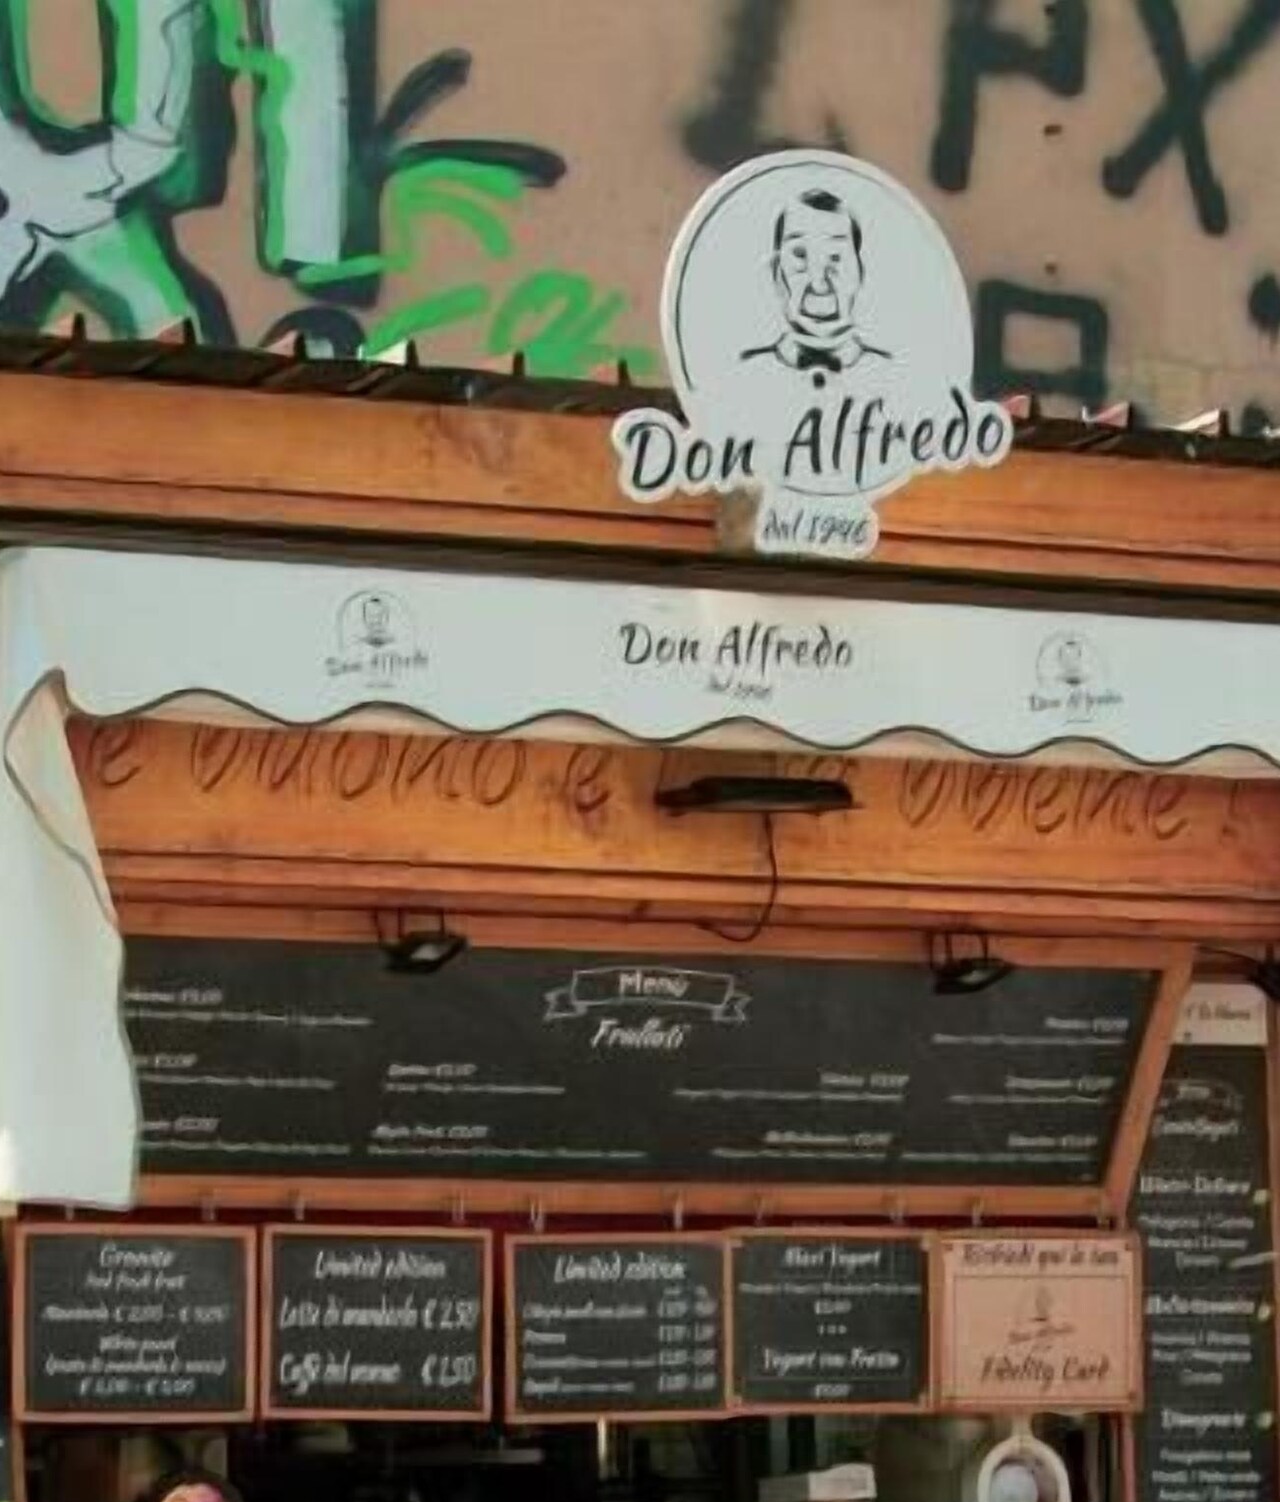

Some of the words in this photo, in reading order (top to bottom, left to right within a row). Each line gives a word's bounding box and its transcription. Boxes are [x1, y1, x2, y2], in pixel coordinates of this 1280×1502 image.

[626, 420, 755, 490] Don
[783, 387, 1005, 486] Alfredo
[619, 622, 701, 665] Don
[715, 620, 854, 677] Alfredo
[980, 1354, 1055, 1393] Fidelity
